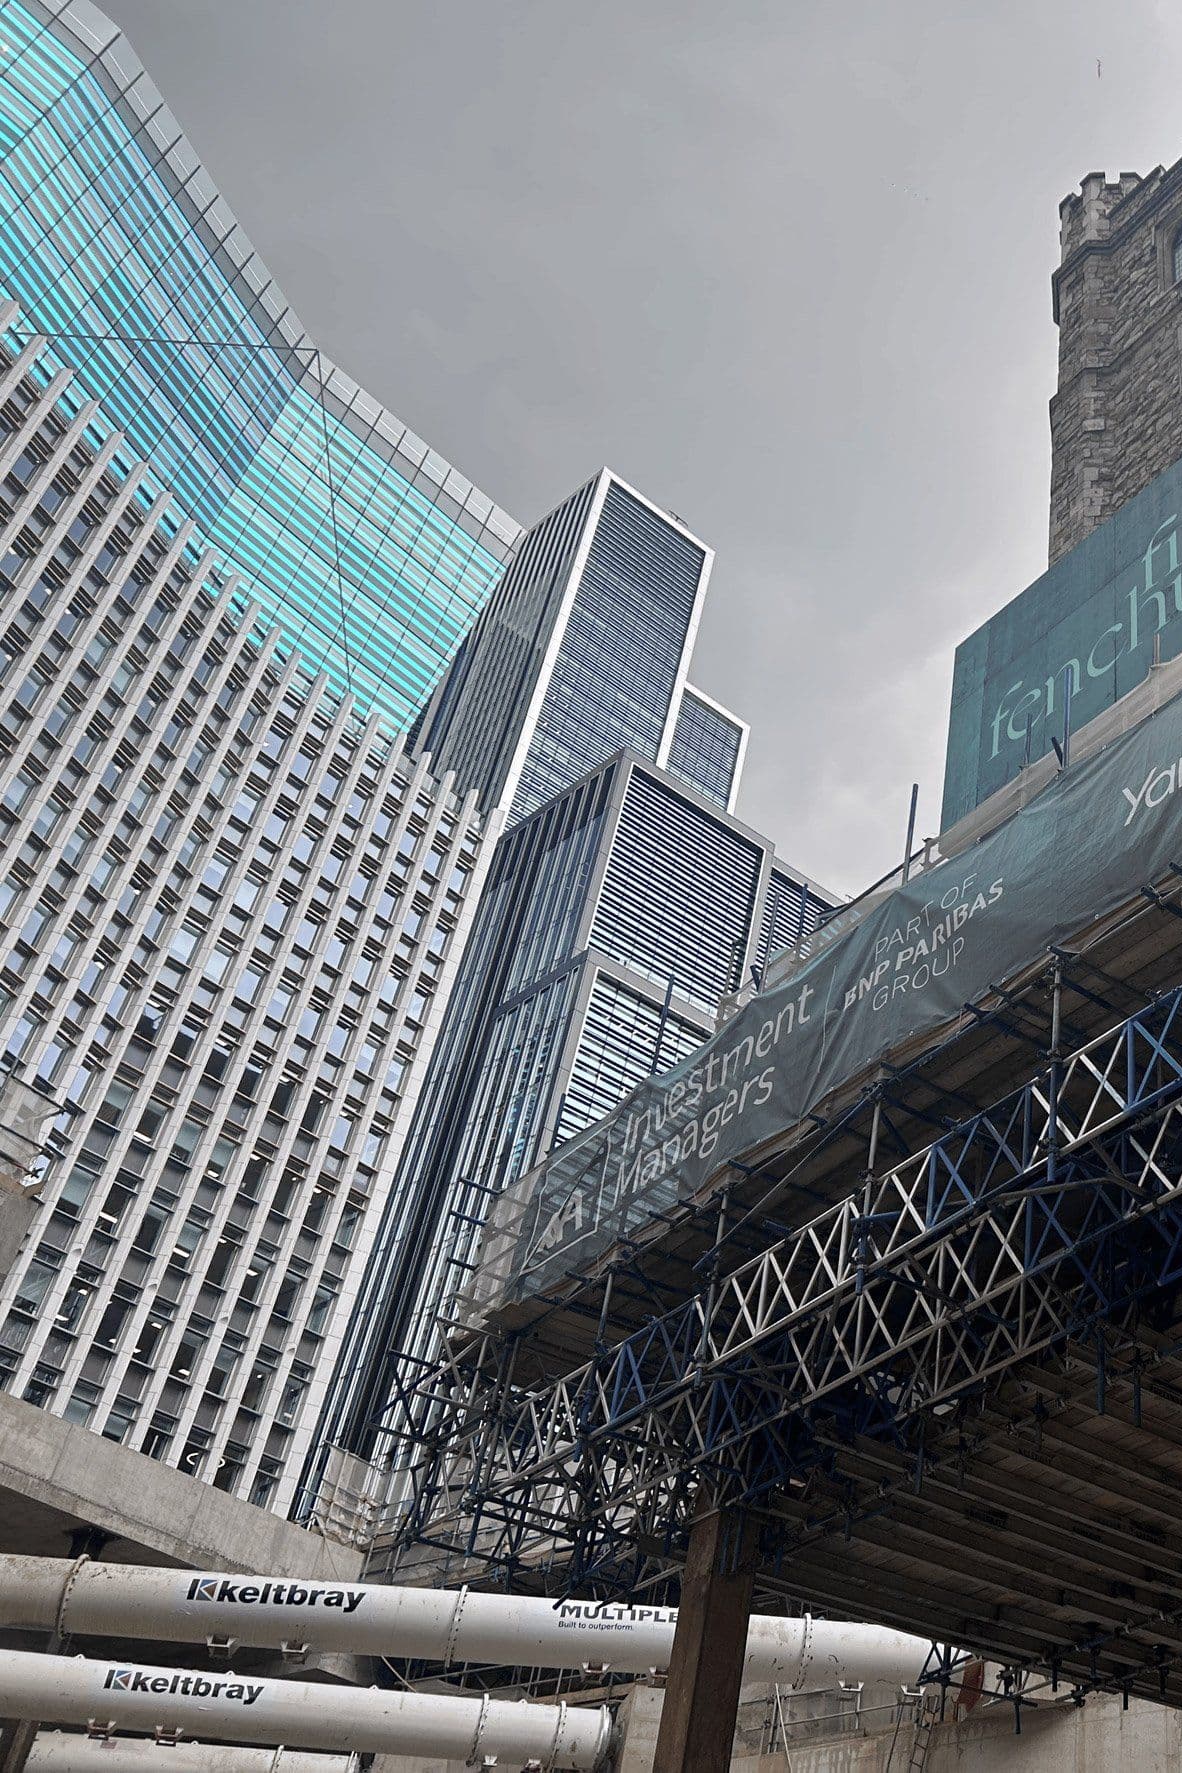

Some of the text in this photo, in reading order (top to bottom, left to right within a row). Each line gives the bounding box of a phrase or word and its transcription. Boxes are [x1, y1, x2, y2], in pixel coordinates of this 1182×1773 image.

[843, 877, 1003, 1010] BNP PARIBAS
[874, 873, 977, 962] PART OF
[872, 937, 964, 1011] GROUP
[622, 983, 814, 1156] Investment
[613, 1066, 775, 1209] Managers
[216, 1580, 366, 1612] keltbray
[558, 1621, 576, 1629] Built
[131, 1672, 264, 1705] keltbray
